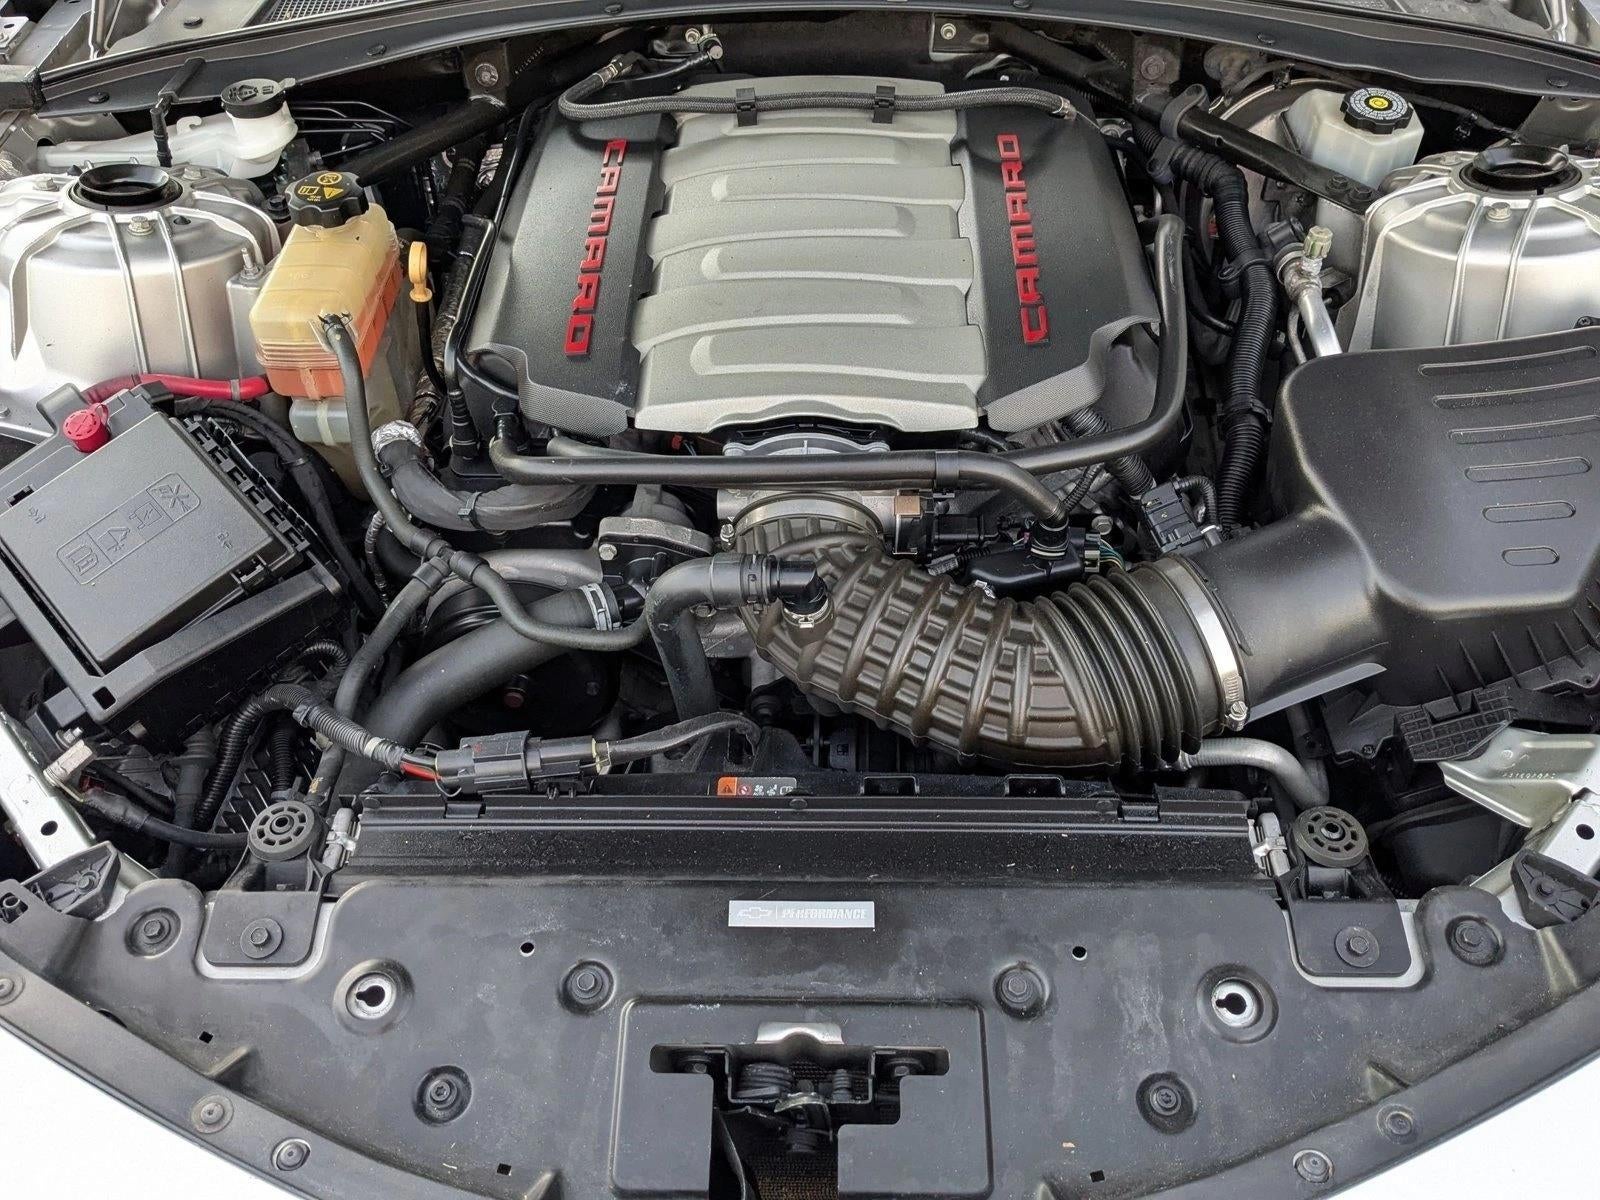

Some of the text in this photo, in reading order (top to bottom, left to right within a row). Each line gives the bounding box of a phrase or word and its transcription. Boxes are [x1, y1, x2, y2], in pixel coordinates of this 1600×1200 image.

[565, 137, 628, 355] CAMARO
[997, 134, 1049, 344] CAMARO
[781, 907, 867, 919] PERFORMANCE
